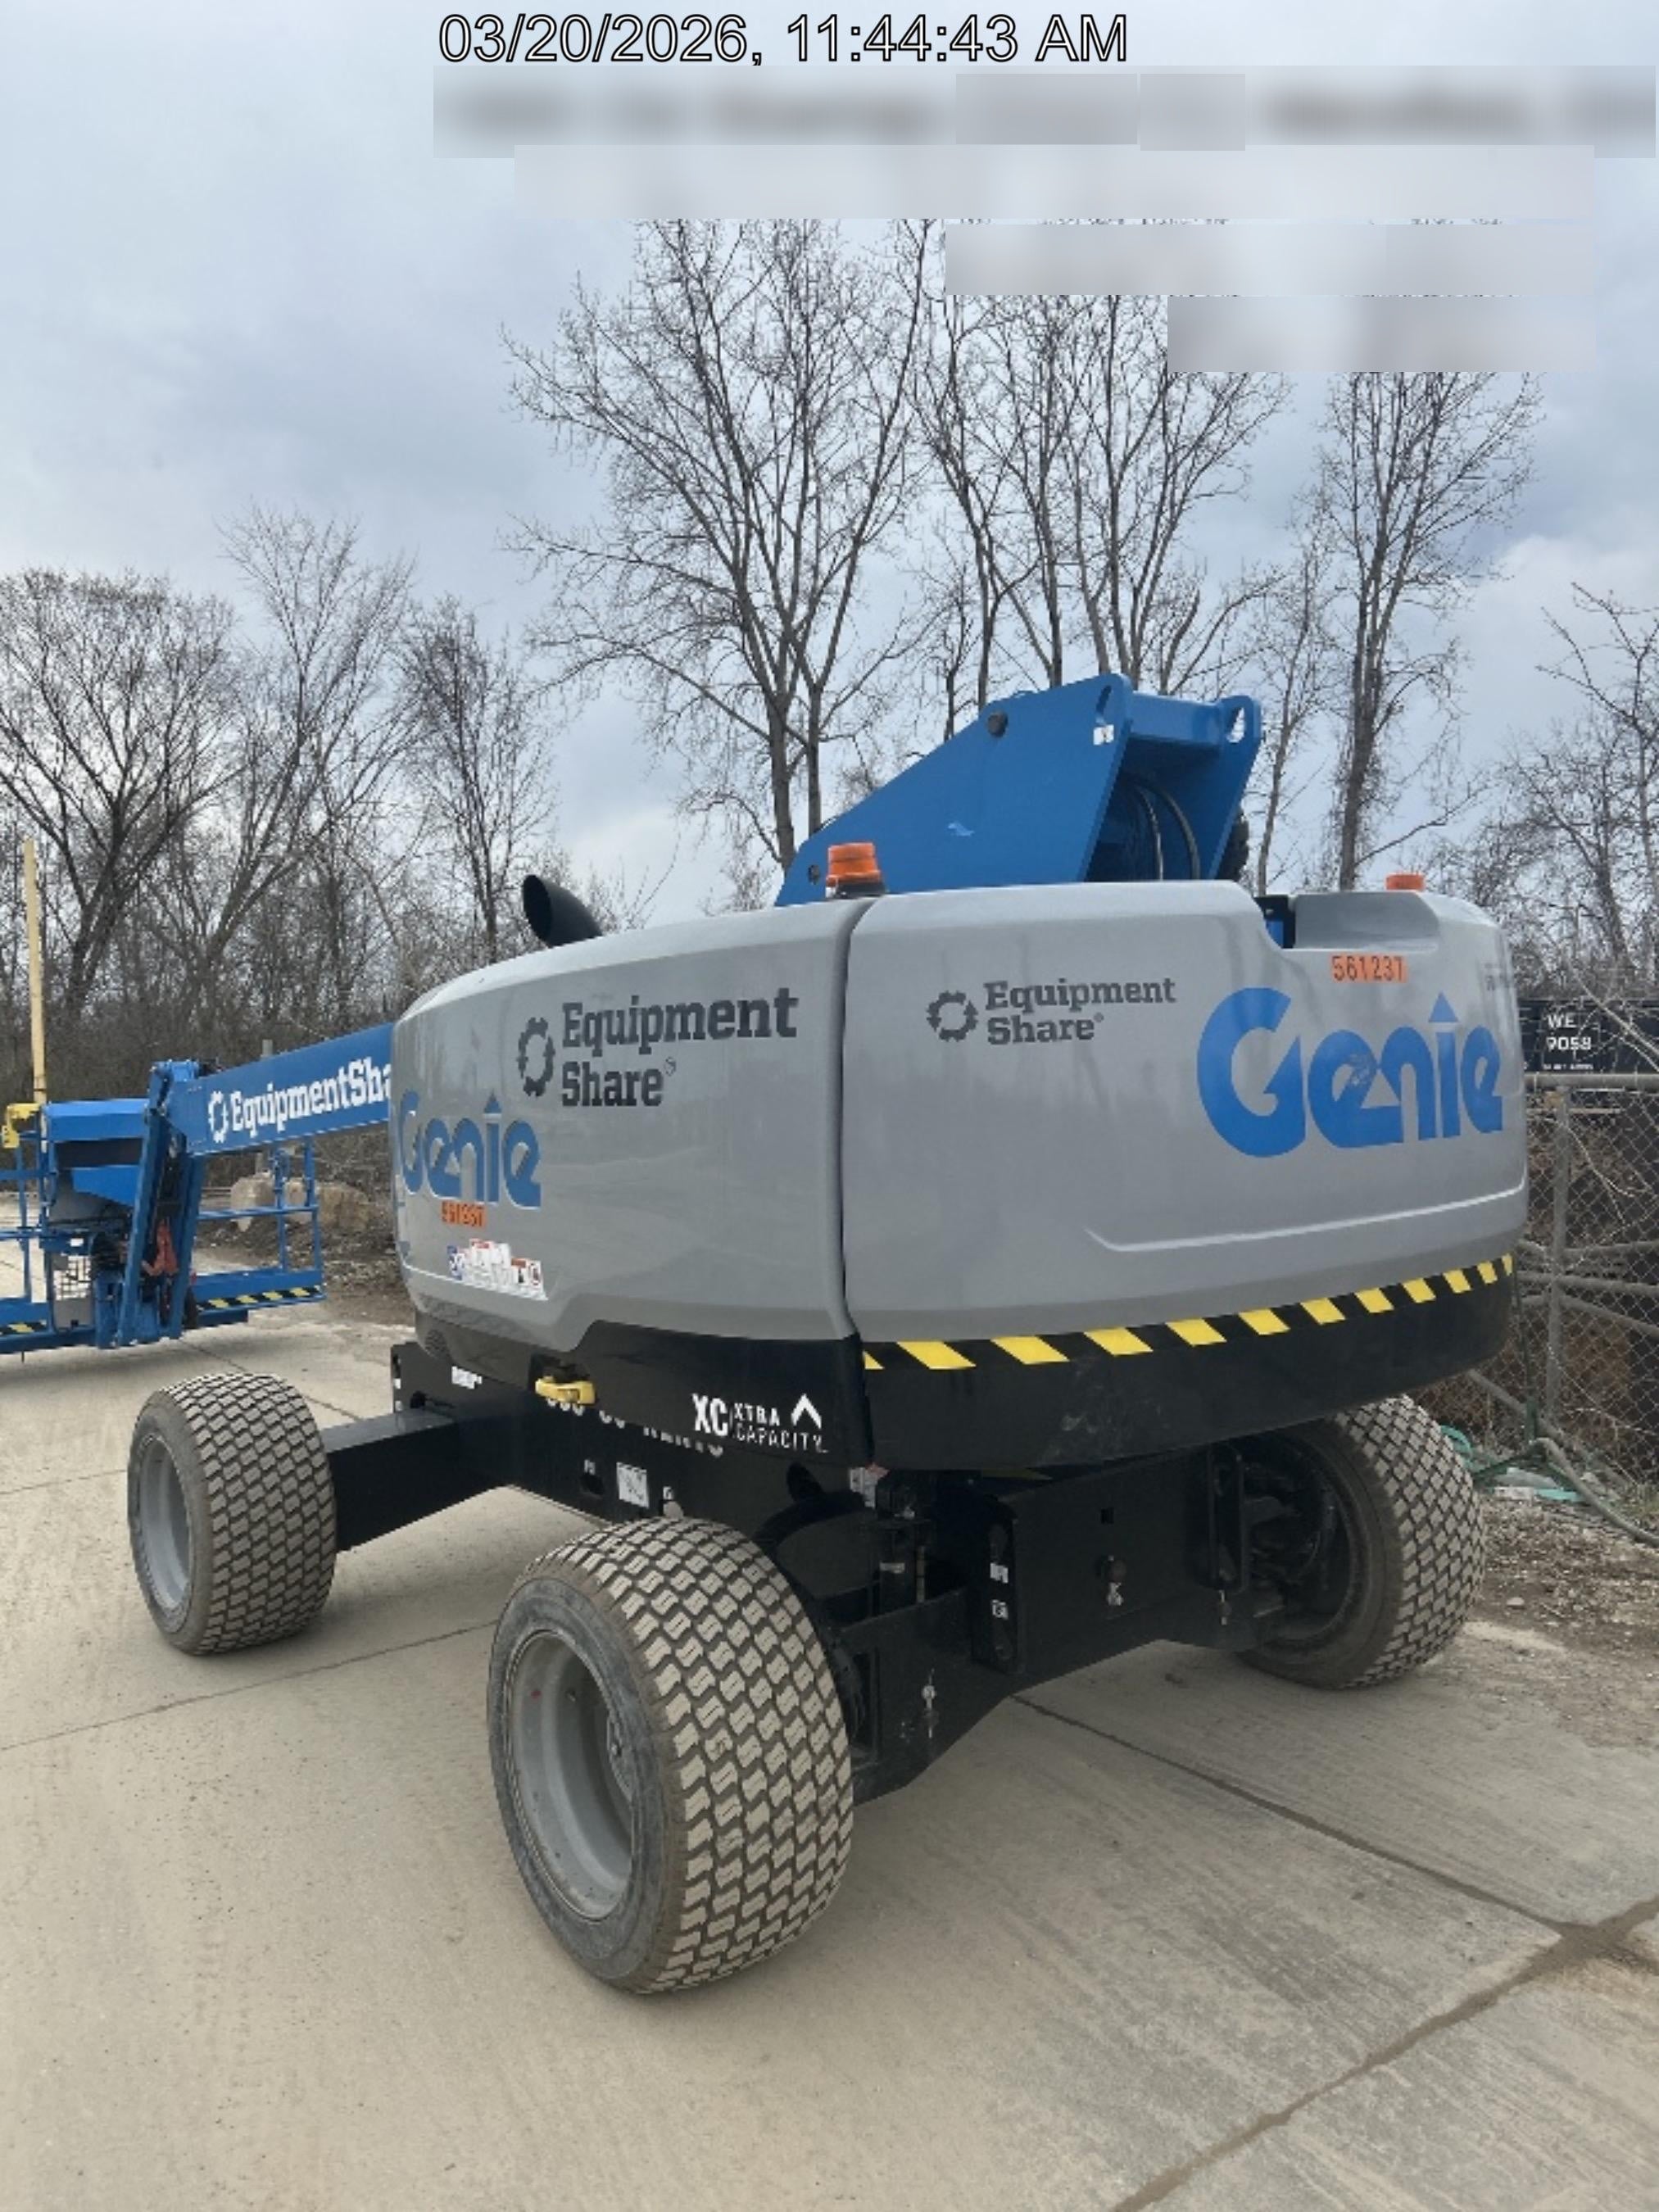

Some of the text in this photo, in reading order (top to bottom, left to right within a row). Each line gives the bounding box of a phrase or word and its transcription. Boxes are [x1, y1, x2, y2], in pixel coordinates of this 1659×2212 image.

[562, 987, 799, 1057] Equipment
[983, 978, 1176, 1013] Equipment
[1197, 987, 1503, 1158] Genie
[398, 1088, 542, 1208] Genie
[692, 1393, 781, 1436] XC XTRA
[735, 1421, 823, 1453] CAPACITY
